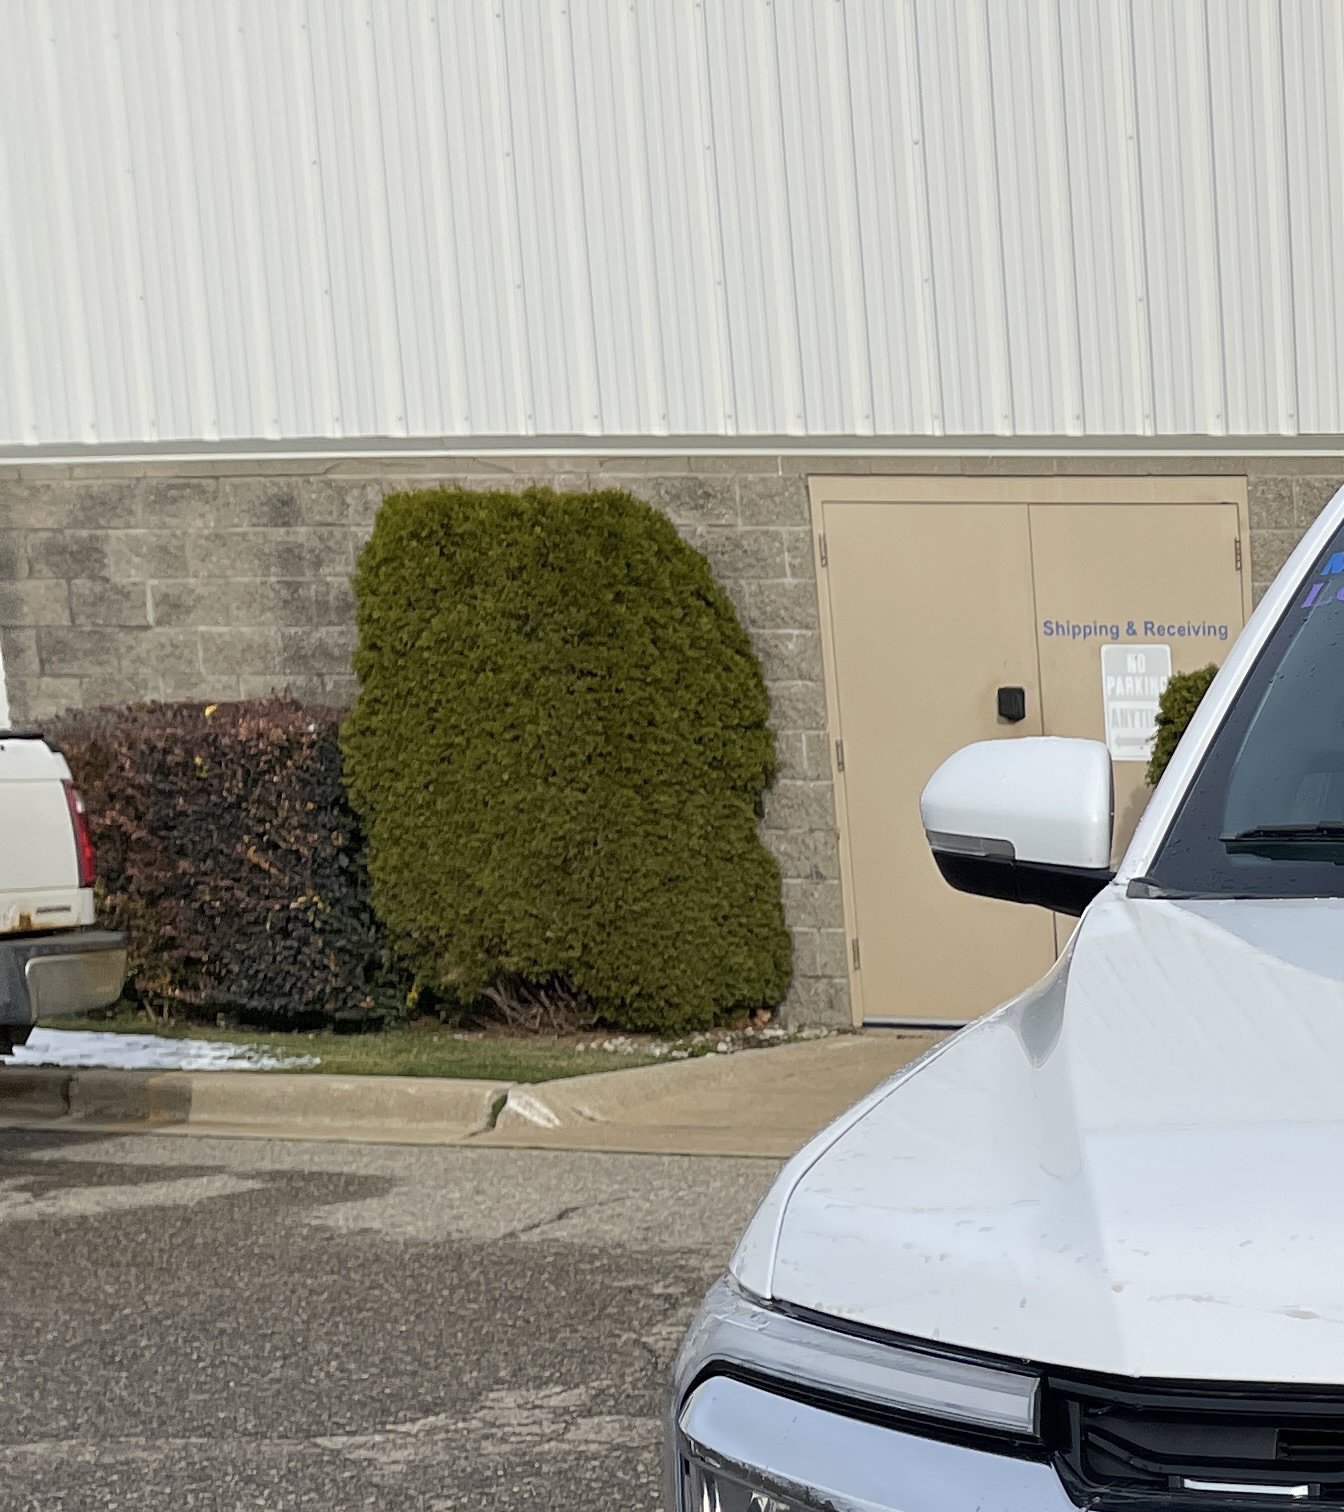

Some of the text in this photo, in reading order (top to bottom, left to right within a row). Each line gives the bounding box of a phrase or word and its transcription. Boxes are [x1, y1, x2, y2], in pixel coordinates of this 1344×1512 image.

[1043, 620, 1228, 640] Shipping & Receiving
[1126, 653, 1146, 673] NO
[1111, 708, 1153, 728] ANYTI
